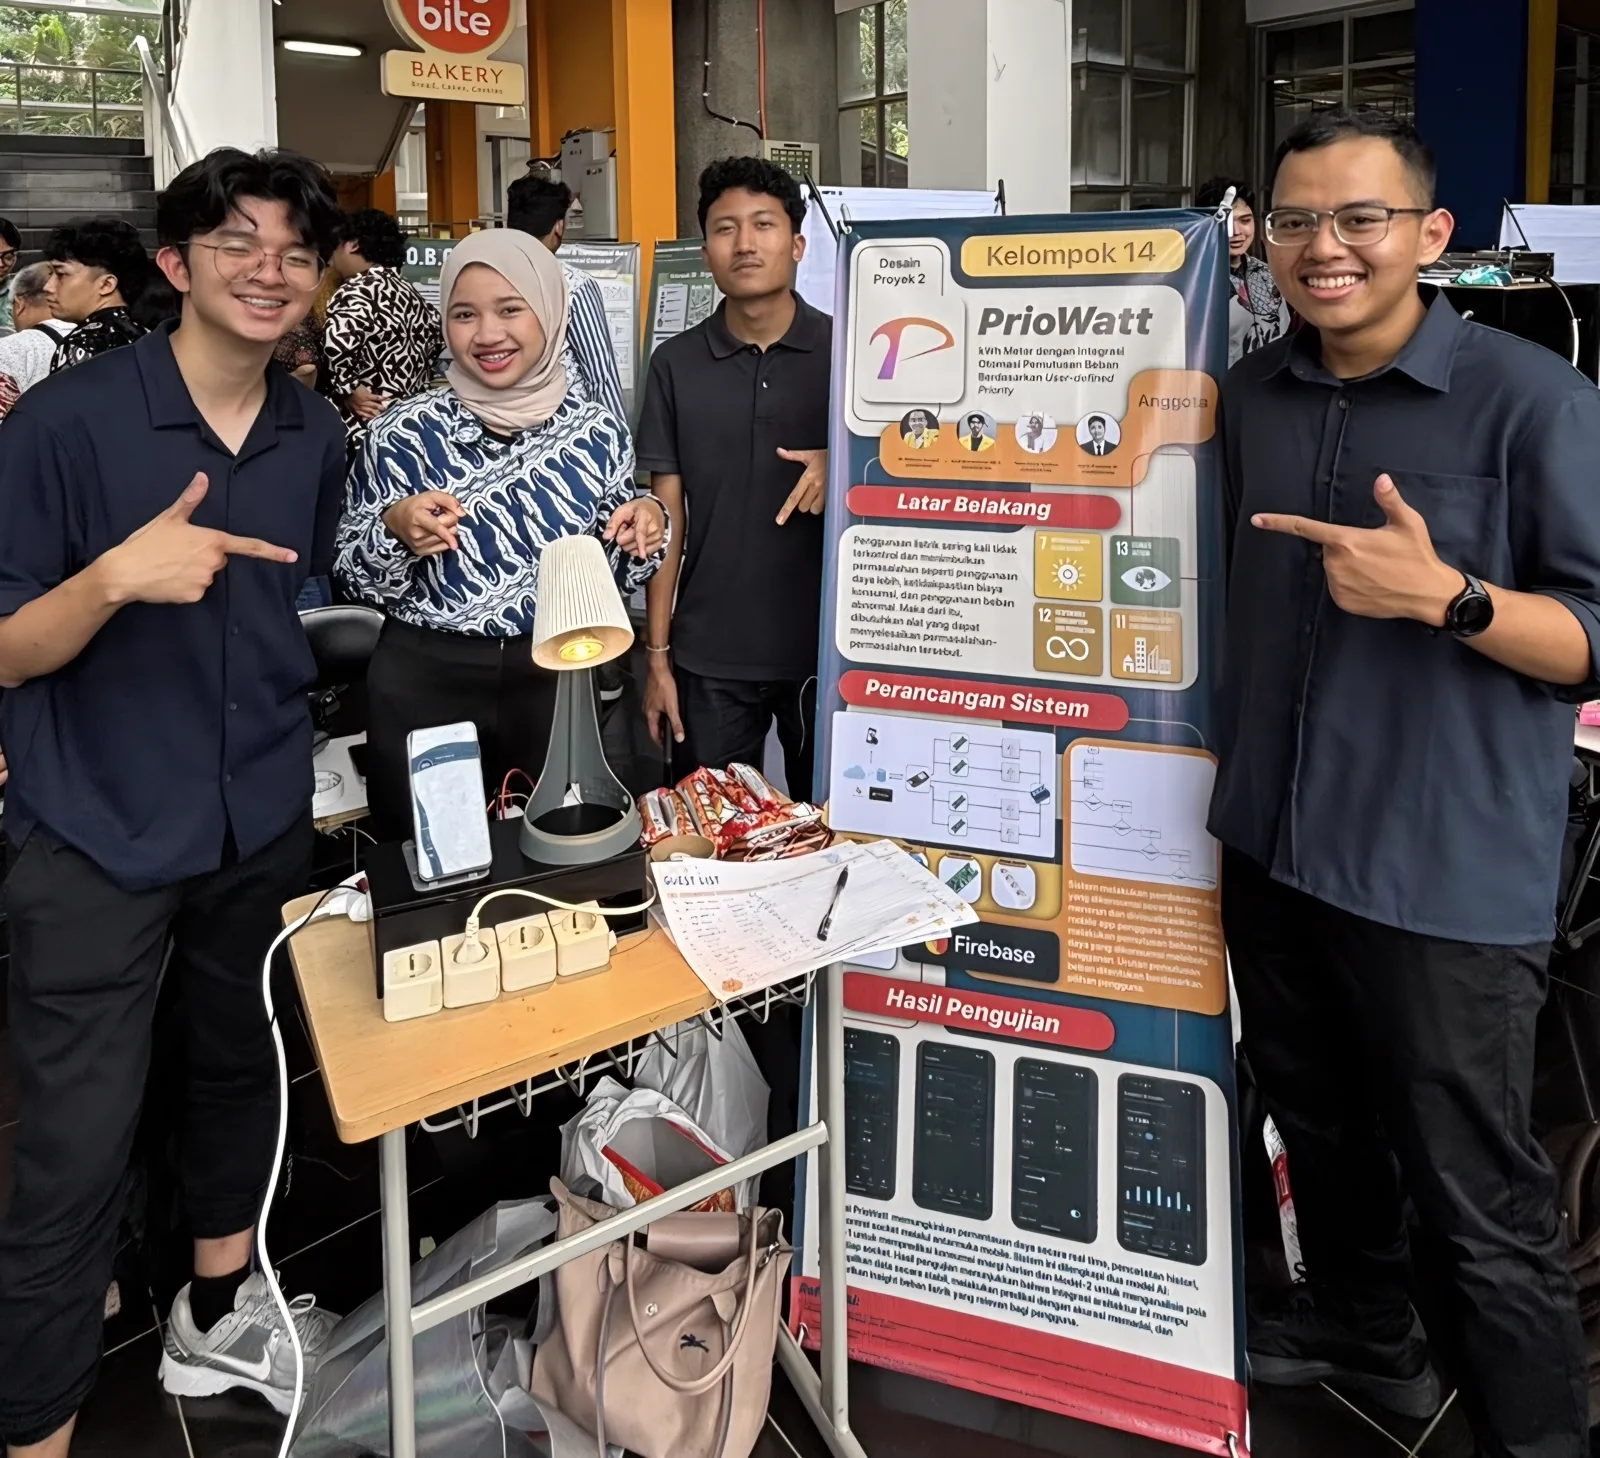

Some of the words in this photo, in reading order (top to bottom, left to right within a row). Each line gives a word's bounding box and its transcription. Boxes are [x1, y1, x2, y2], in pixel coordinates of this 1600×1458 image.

[418, 0, 491, 36] bite
[410, 61, 503, 84] BAKERY
[987, 242, 1117, 269] Kelompok
[1123, 240, 1156, 263] 14
[917, 273, 926, 284] 2
[977, 305, 1154, 336] PrioWatt
[1138, 393, 1209, 410] Anggota
[897, 493, 951, 511] Latar
[953, 496, 1051, 521] Belakang
[1039, 536, 1047, 550] 7
[1115, 540, 1129, 556] 13
[1038, 607, 1052, 623] 12
[1115, 614, 1126, 629] 11
[864, 678, 1006, 711] Perancangan
[1009, 692, 1090, 718] Sistem
[663, 875, 695, 886] GUEST
[698, 875, 719, 885] LIST
[954, 934, 1036, 964] Firebase
[886, 987, 942, 1014] Hasil
[945, 997, 1060, 1034] Pengujian
